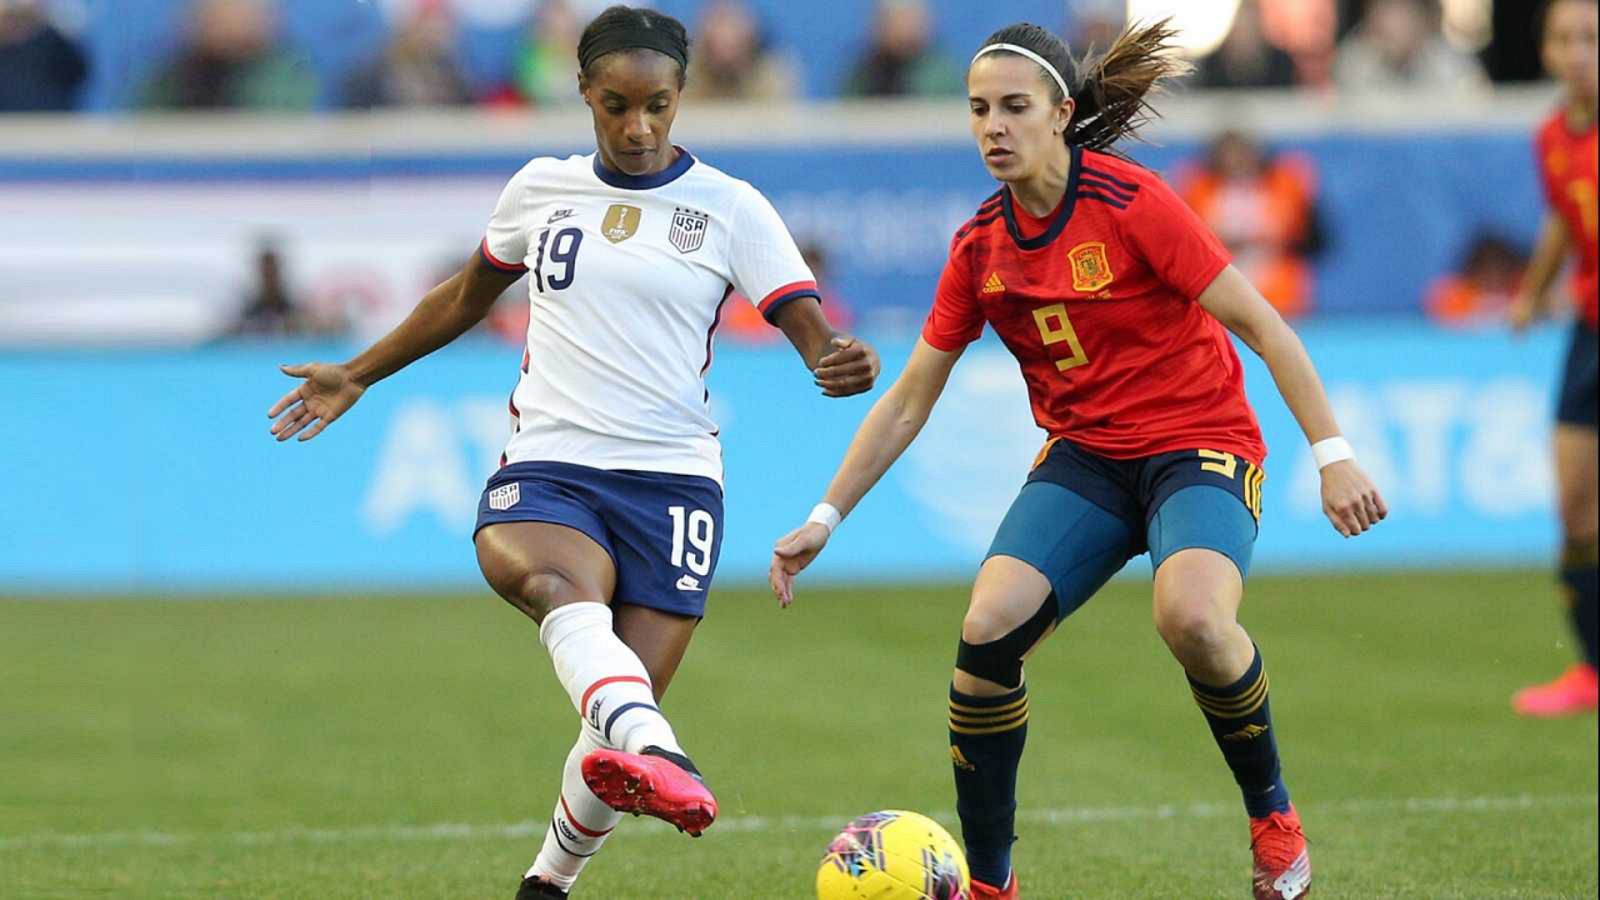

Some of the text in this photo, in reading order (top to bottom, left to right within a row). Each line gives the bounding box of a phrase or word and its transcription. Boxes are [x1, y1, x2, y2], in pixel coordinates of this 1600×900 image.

[676, 216, 704, 232] USA
[534, 227, 584, 293] 19
[1032, 302, 1089, 372] 9
[491, 484, 518, 498] USA
[668, 506, 715, 576] 19
